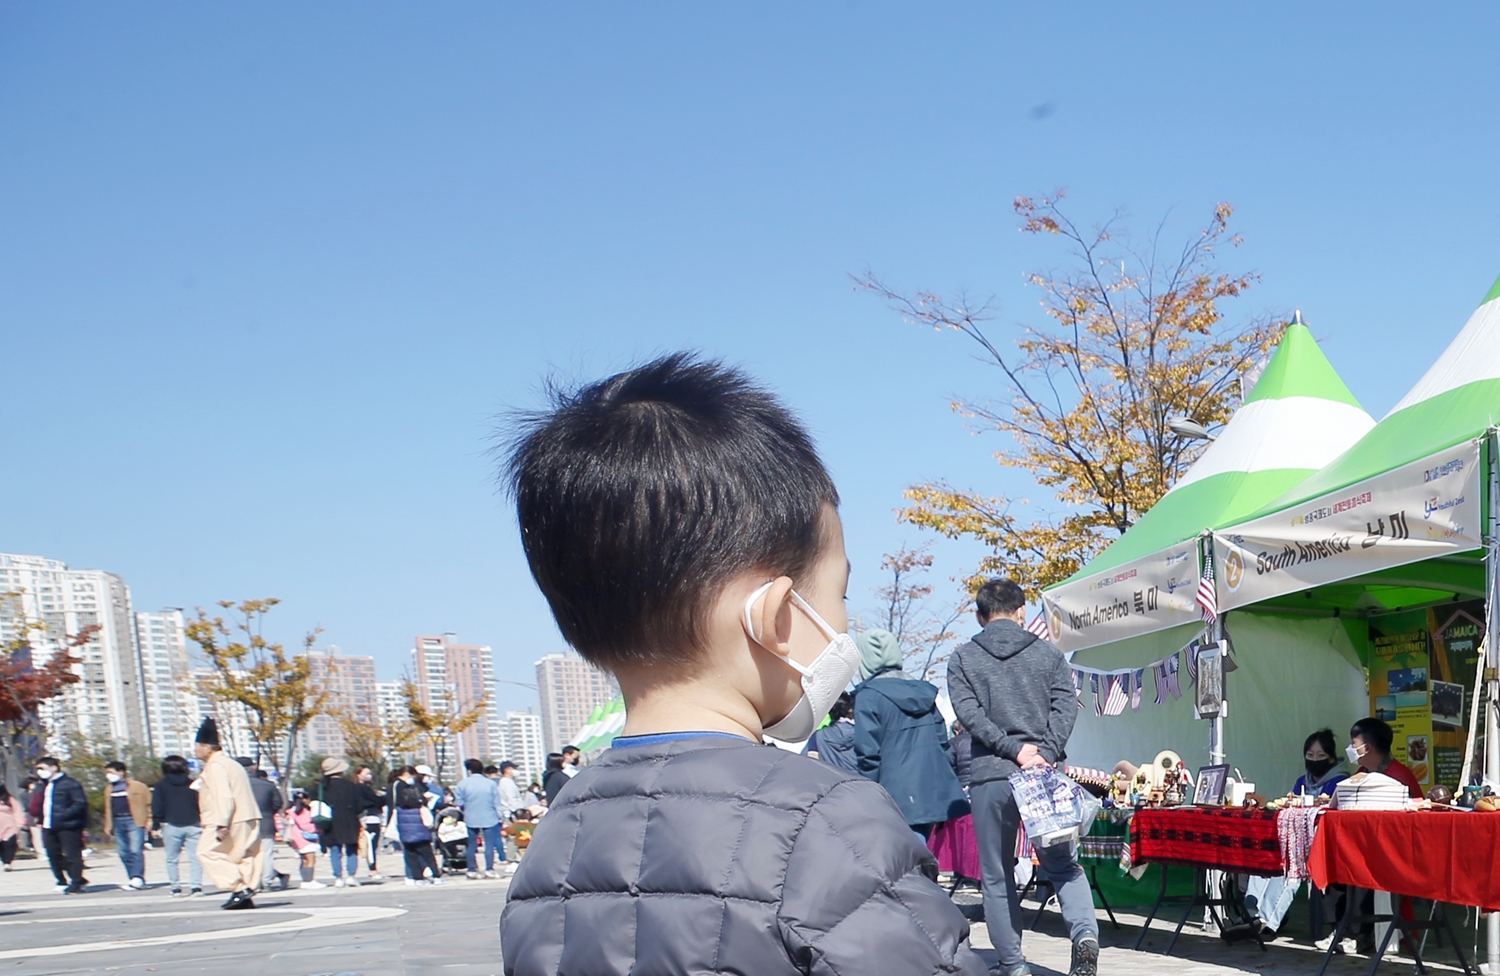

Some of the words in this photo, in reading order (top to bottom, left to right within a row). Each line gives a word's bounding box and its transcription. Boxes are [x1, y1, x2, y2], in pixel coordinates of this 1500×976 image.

[1257, 543, 1297, 575] South
[1297, 532, 1354, 564] America
[1361, 518, 1385, 549] 남
[1389, 510, 1409, 540] 미
[1230, 558, 1238, 582] 2
[1069, 609, 1092, 631] North
[1092, 598, 1129, 625] America
[1133, 590, 1145, 615] 북
[1147, 586, 1159, 612] 미
[1444, 624, 1478, 639] JAMAICA
